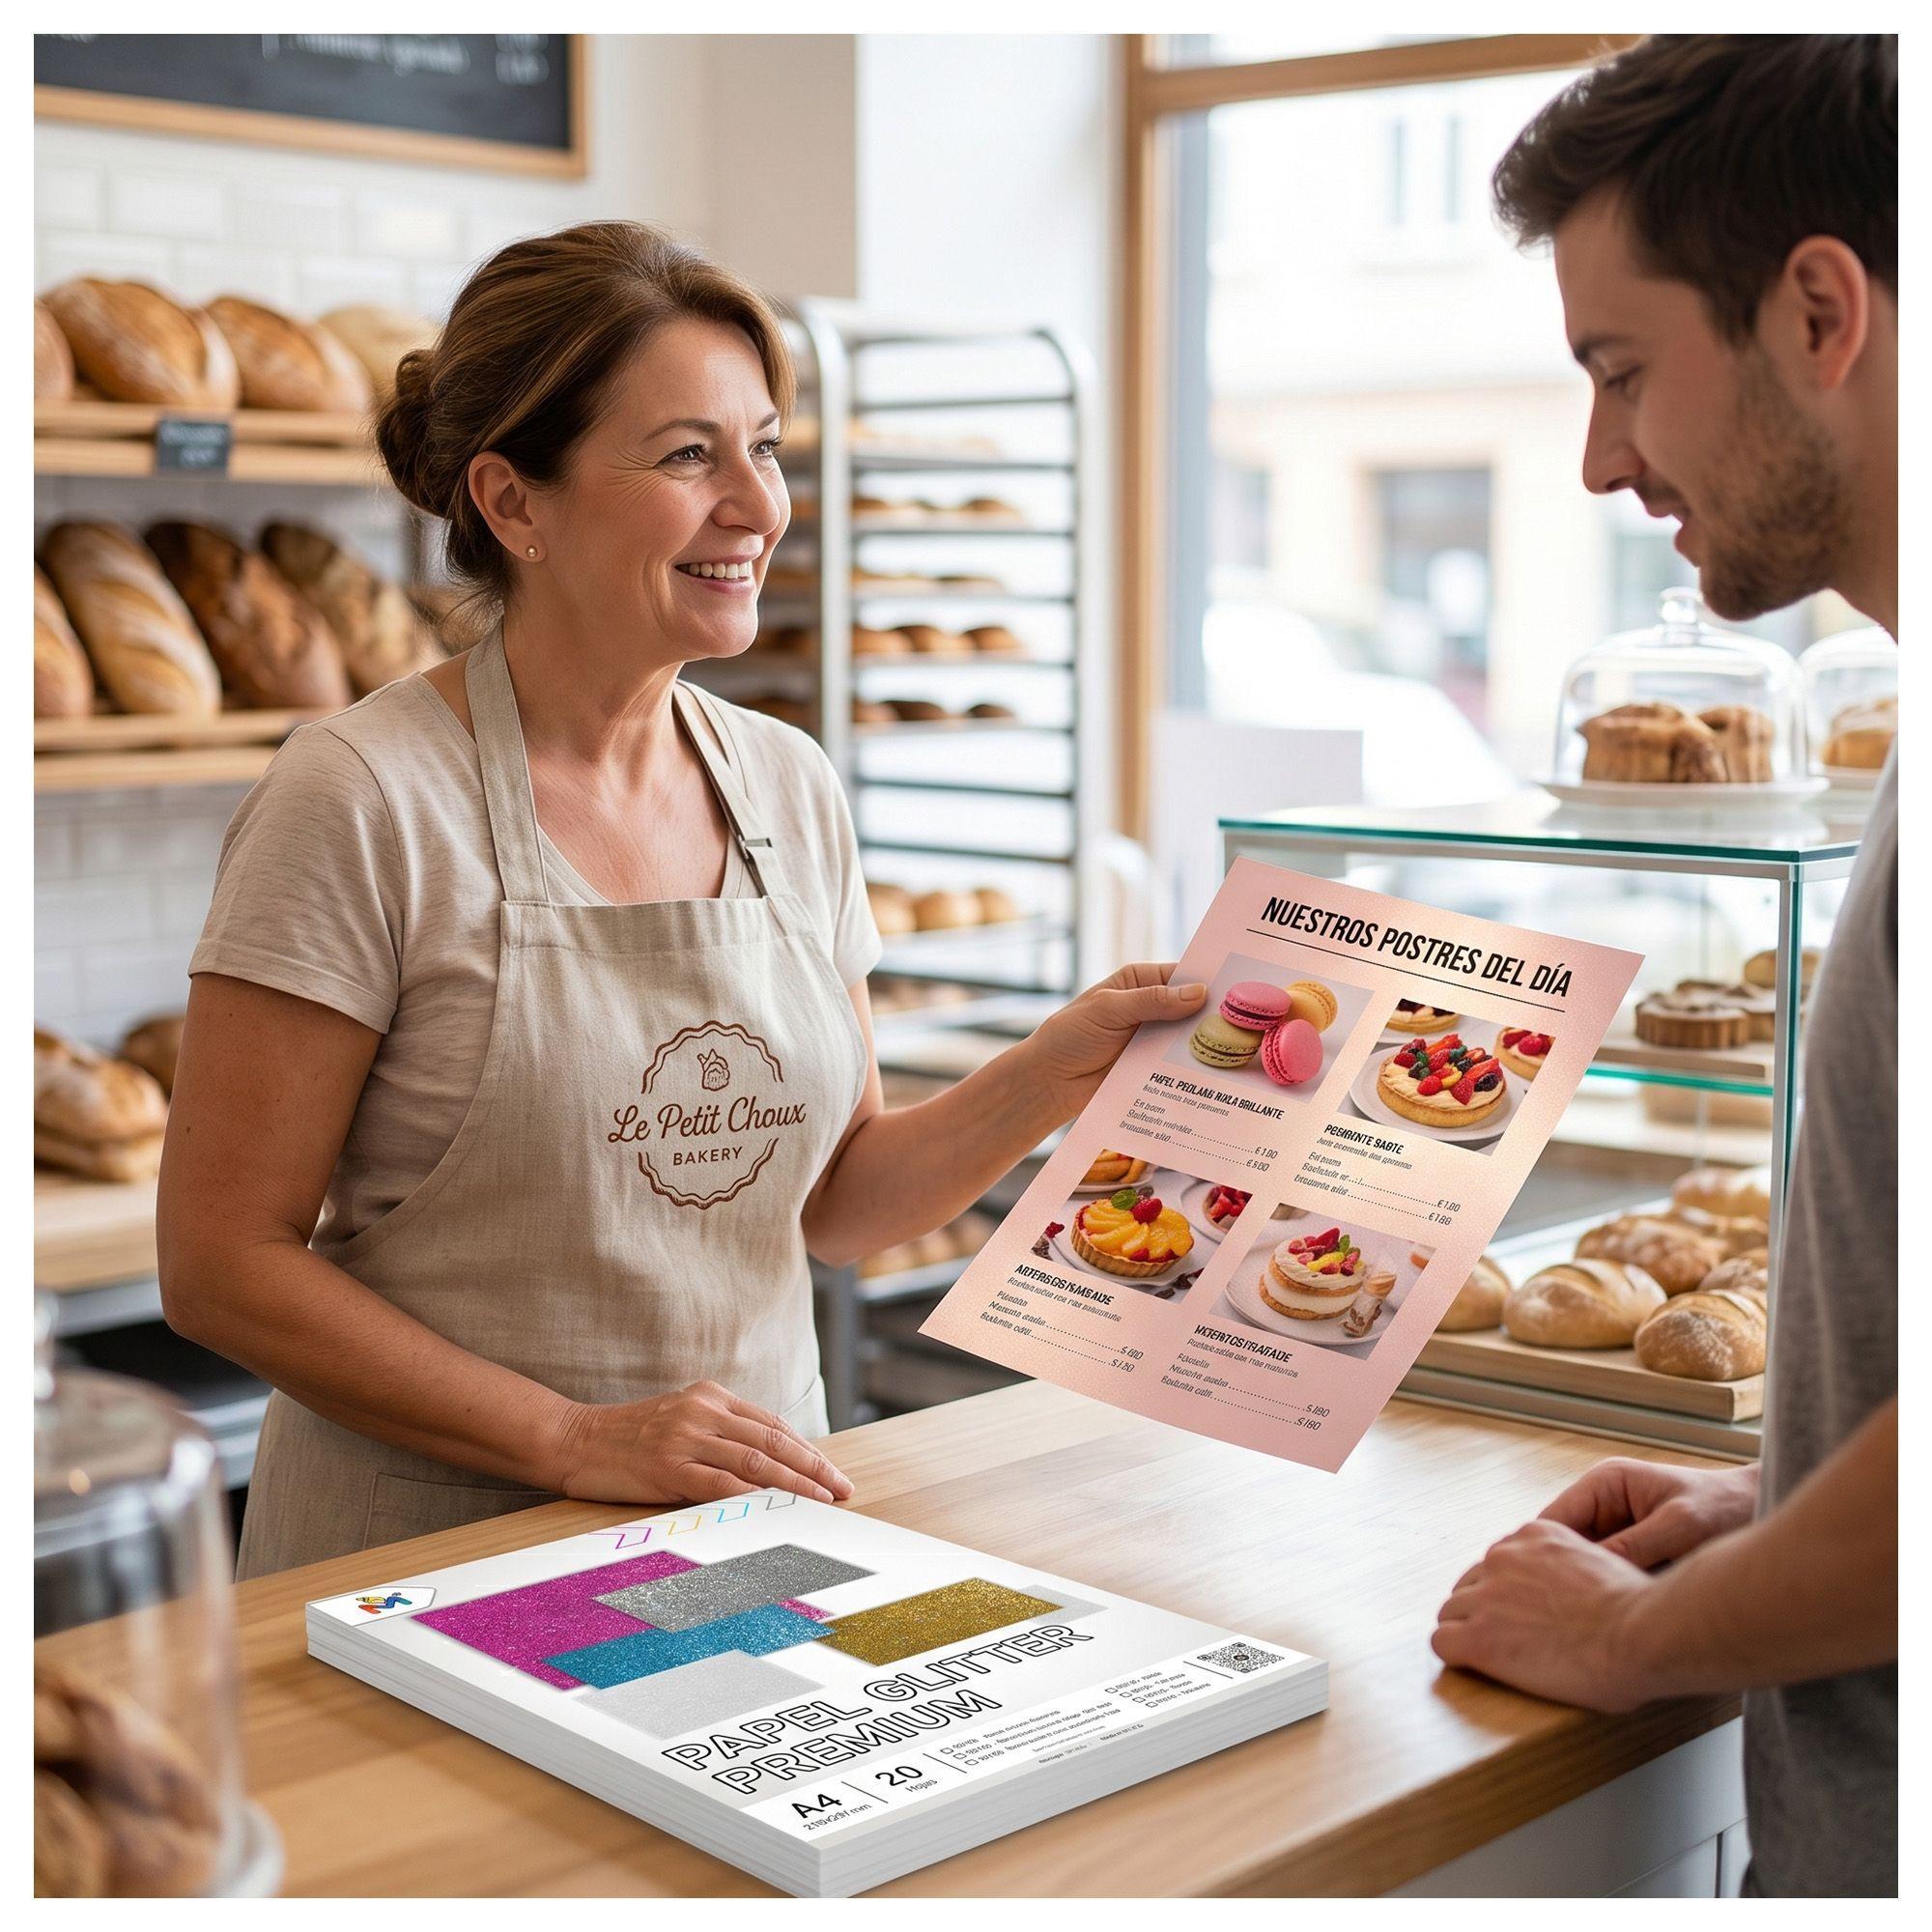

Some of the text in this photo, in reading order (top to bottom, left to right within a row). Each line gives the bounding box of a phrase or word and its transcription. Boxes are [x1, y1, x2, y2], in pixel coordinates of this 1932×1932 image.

[1261, 896, 1573, 997] NUESTROS POSTRES DEL DÍA
[608, 1095, 807, 1143] Le Petit Choux
[1237, 1098, 1285, 1120] BRILLANTE
[672, 1146, 743, 1166] BAKERY
[662, 1699, 872, 1772] PAPEL
[863, 1624, 1094, 1703] GLITTER
[711, 1688, 1003, 1795] PREMIUM
[874, 1765, 923, 1787] 20
[791, 1793, 842, 1819] A4
